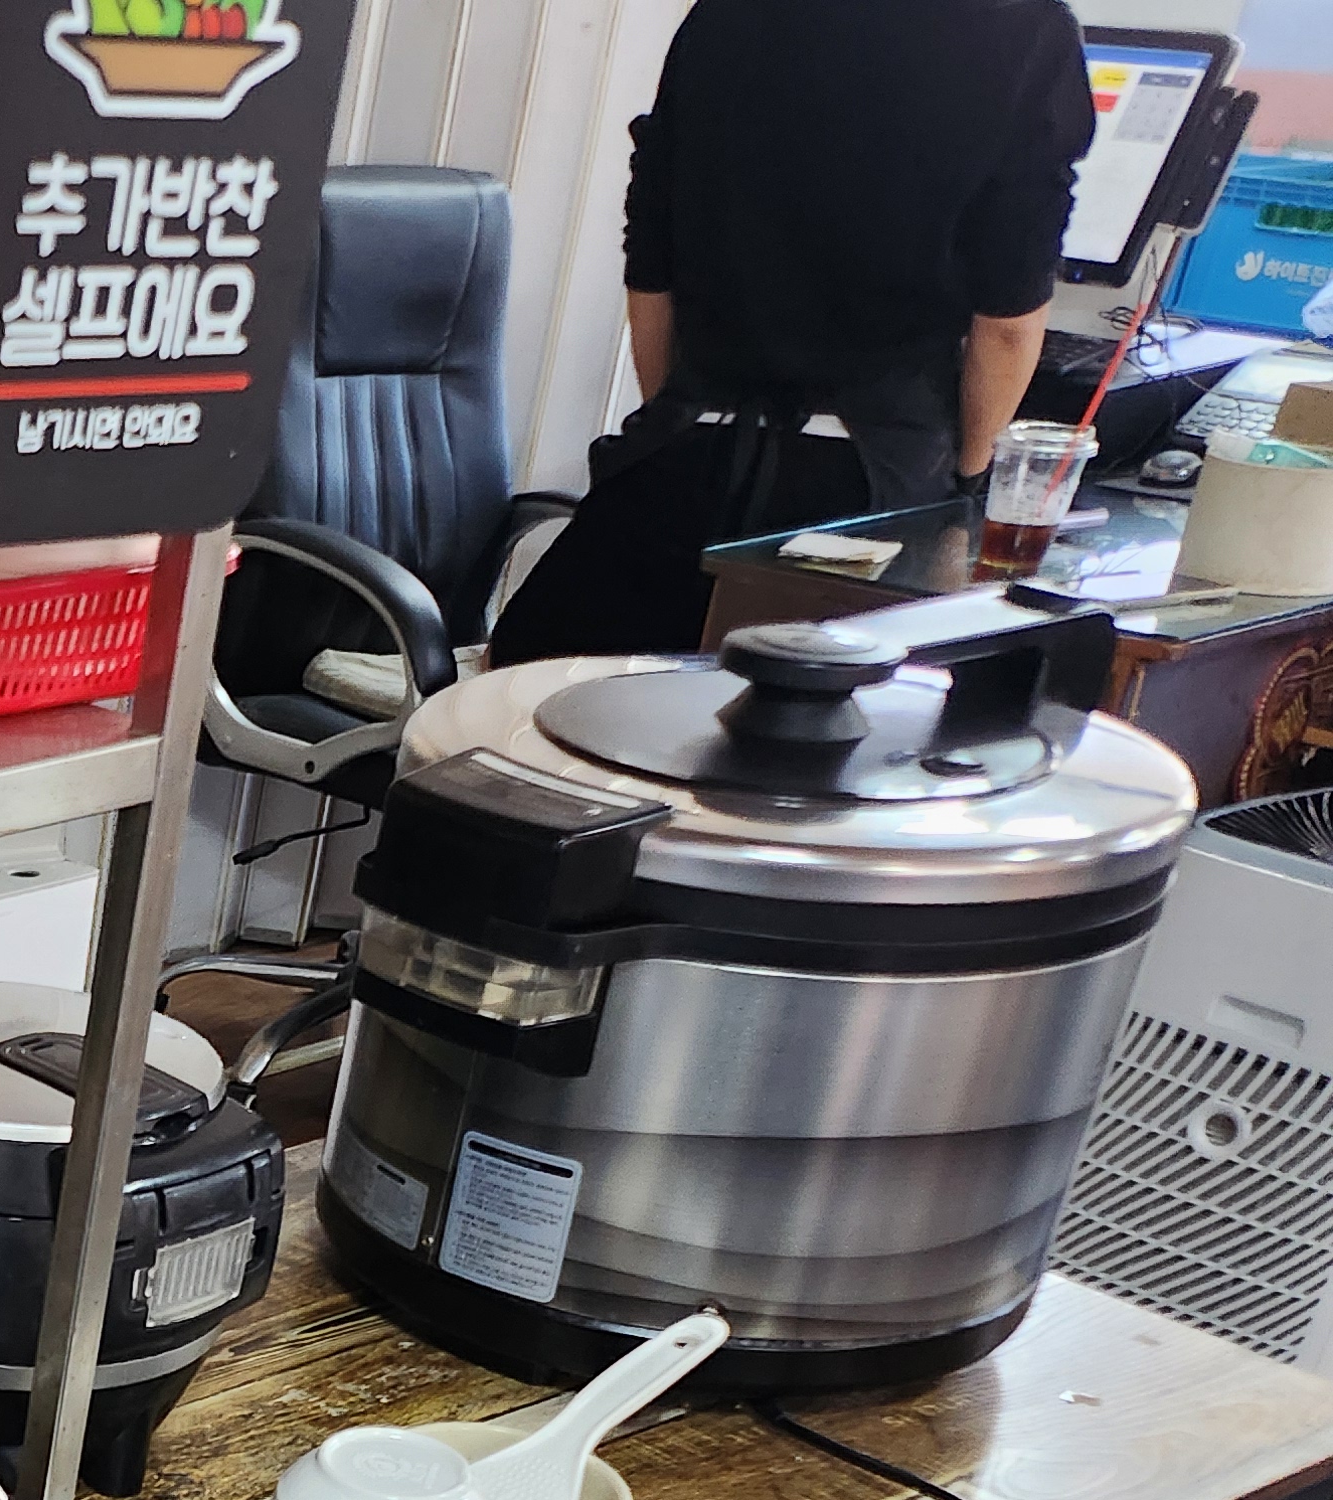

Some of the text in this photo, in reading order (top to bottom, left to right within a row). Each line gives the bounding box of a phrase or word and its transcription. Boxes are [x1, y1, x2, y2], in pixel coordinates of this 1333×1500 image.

[16, 151, 279, 258] 추가반찬
[0, 263, 255, 367] 셀프에요
[18, 407, 124, 453] 남기시면
